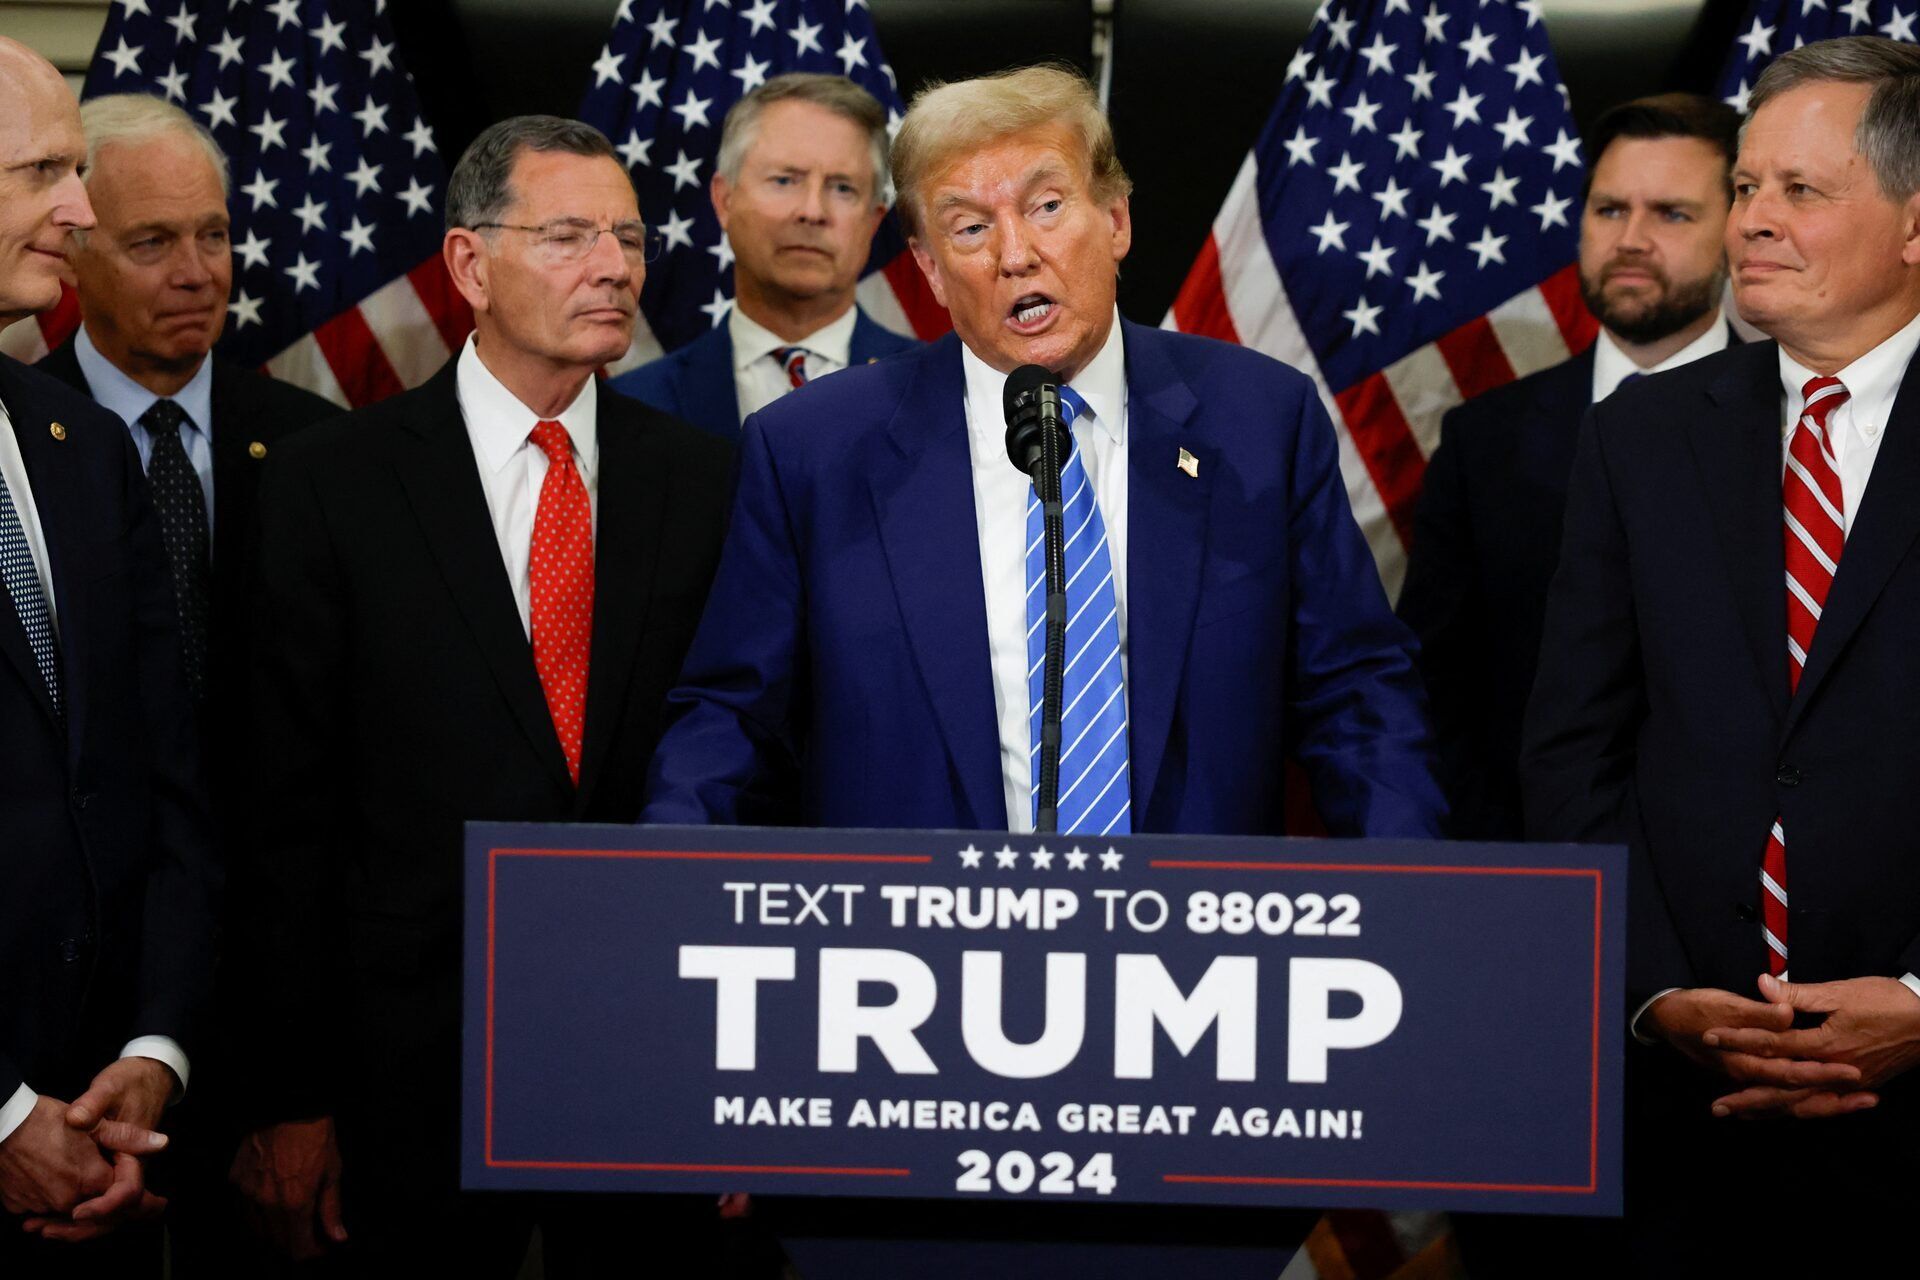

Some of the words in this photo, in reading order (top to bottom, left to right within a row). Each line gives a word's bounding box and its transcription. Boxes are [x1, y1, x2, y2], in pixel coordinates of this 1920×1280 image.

[723, 882, 866, 926] TEXT
[881, 885, 1079, 931] TRUMP
[1094, 889, 1169, 933] TO
[1185, 890, 1361, 937] 88022
[678, 944, 1403, 1084] TRUMP
[714, 1096, 833, 1128] MAKE
[847, 1098, 1042, 1132] AMERICA
[1056, 1103, 1197, 1135] GREAT
[1211, 1106, 1363, 1139] AGAIN!
[955, 1149, 1117, 1195] 2024
